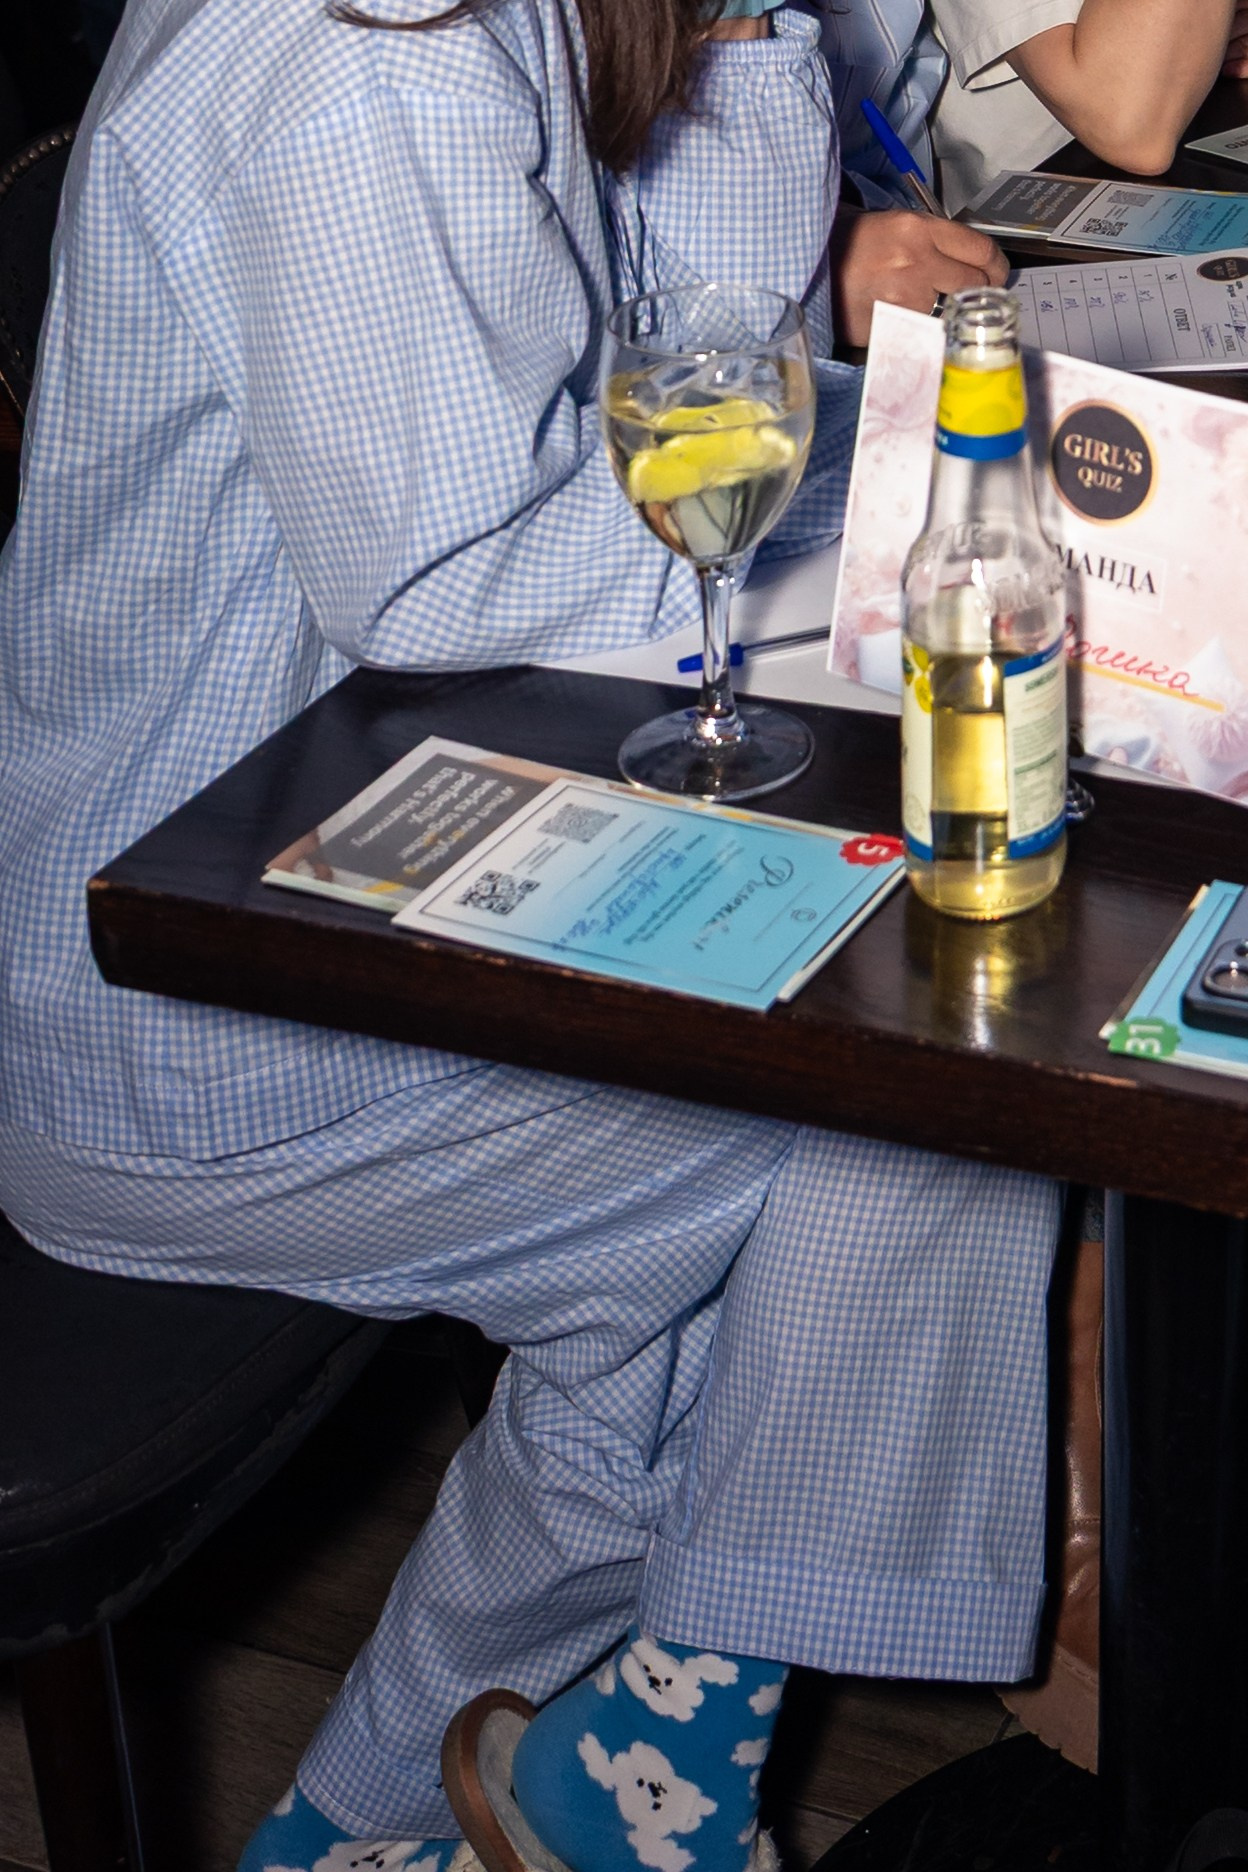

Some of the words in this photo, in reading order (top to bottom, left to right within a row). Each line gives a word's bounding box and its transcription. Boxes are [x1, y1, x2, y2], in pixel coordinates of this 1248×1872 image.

[1173, 308, 1190, 332] ОТВЕТ
[1063, 433, 1143, 476] GIRL'S
[1077, 467, 1124, 492] QUIZ
[1055, 543, 1157, 595] МАНДА
[857, 841, 889, 856] 5
[1125, 1024, 1162, 1054] 31
